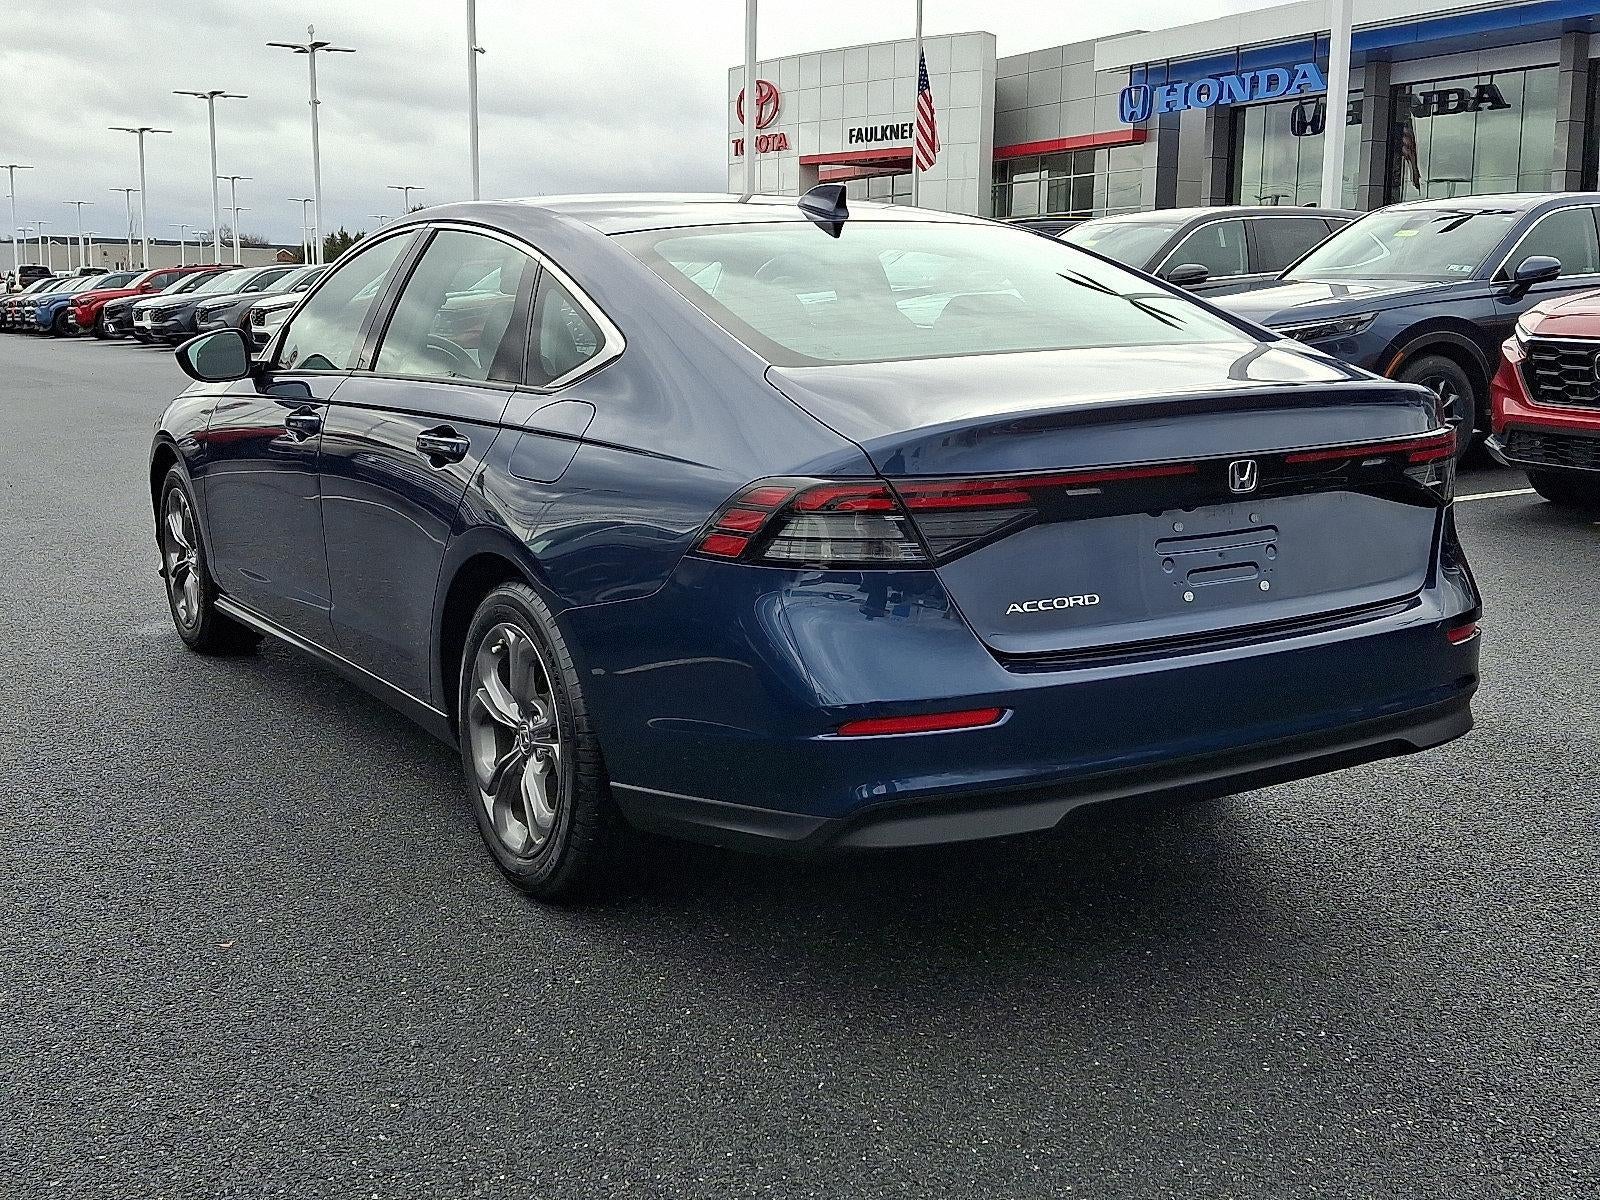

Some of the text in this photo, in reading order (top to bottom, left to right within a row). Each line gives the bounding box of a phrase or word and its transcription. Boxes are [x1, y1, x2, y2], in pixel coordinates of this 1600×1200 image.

[1155, 63, 1326, 113] HONDA
[732, 133, 788, 156] TOTA
[1006, 594, 1100, 615] ACCORD
